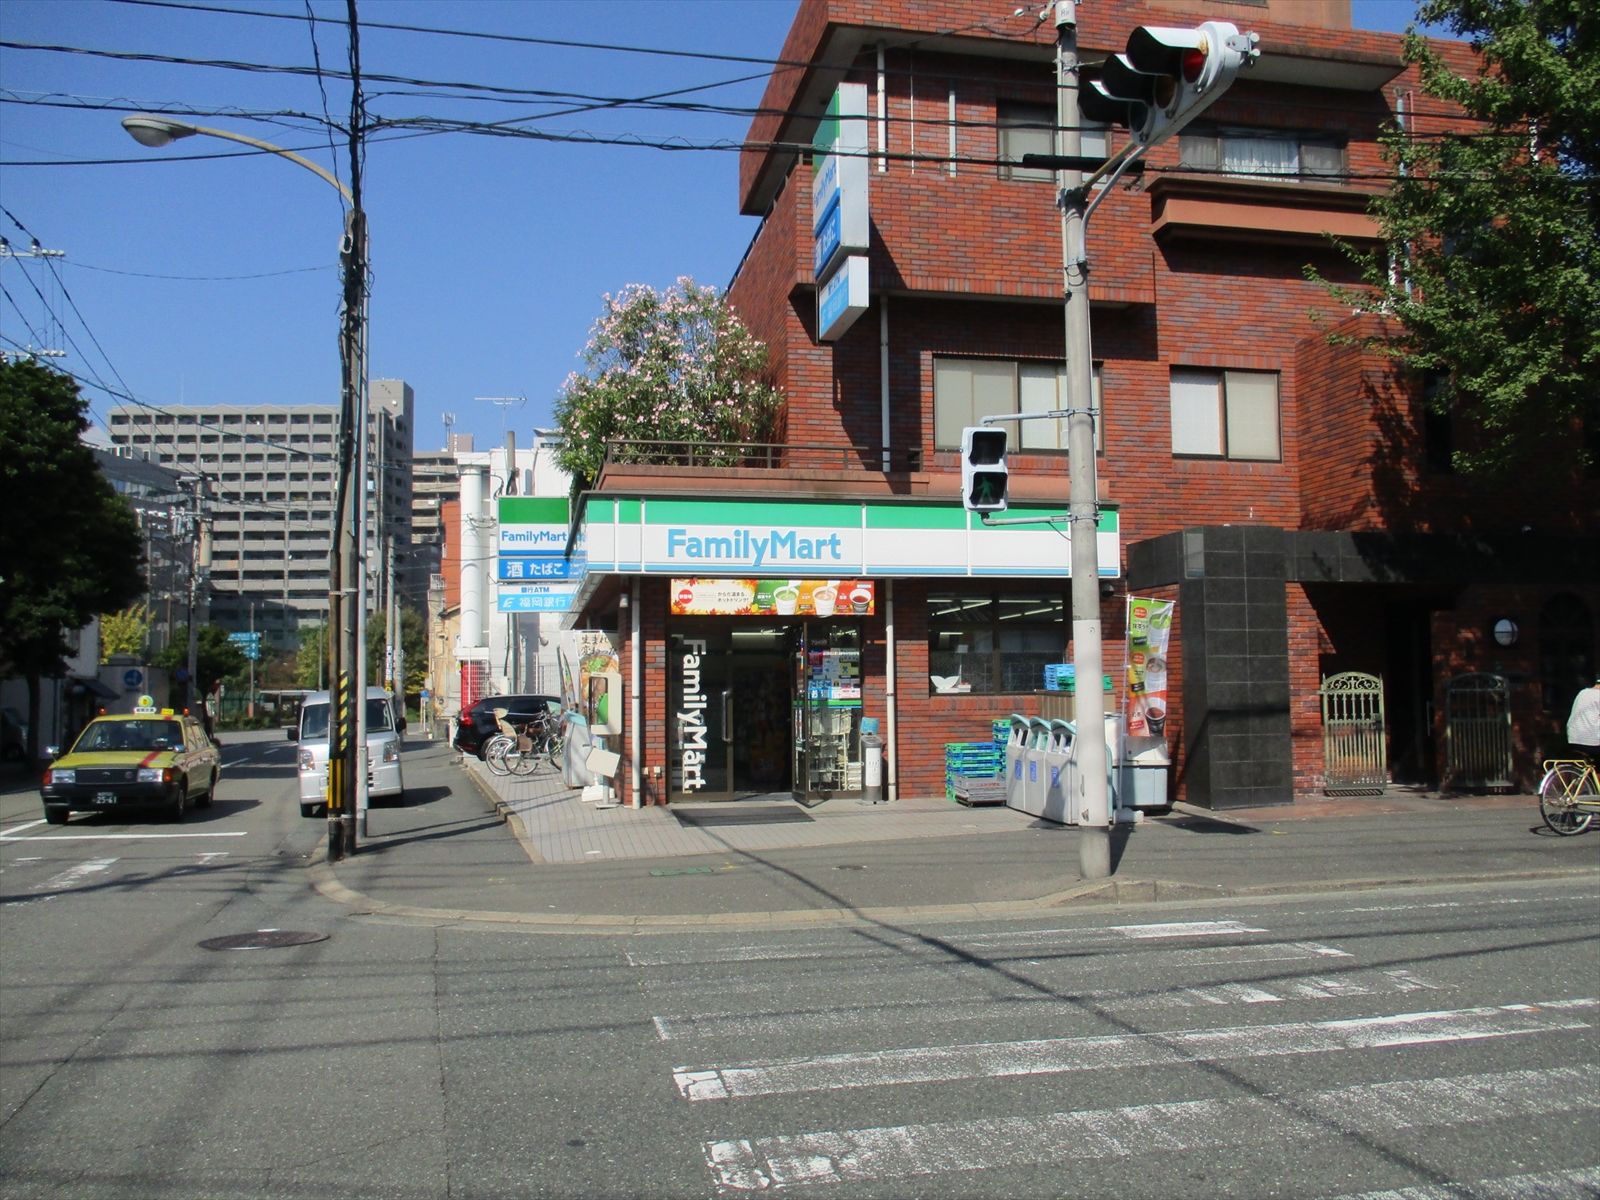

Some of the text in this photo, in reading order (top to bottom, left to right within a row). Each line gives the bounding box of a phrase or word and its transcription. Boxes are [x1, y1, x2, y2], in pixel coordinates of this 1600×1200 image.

[501, 531, 567, 544] FamilyMart
[668, 529, 841, 567] FamilyMart
[507, 562, 564, 578] 酒 たばこ
[519, 597, 566, 608] 福岡銀行
[677, 639, 707, 789] FamilyMart
